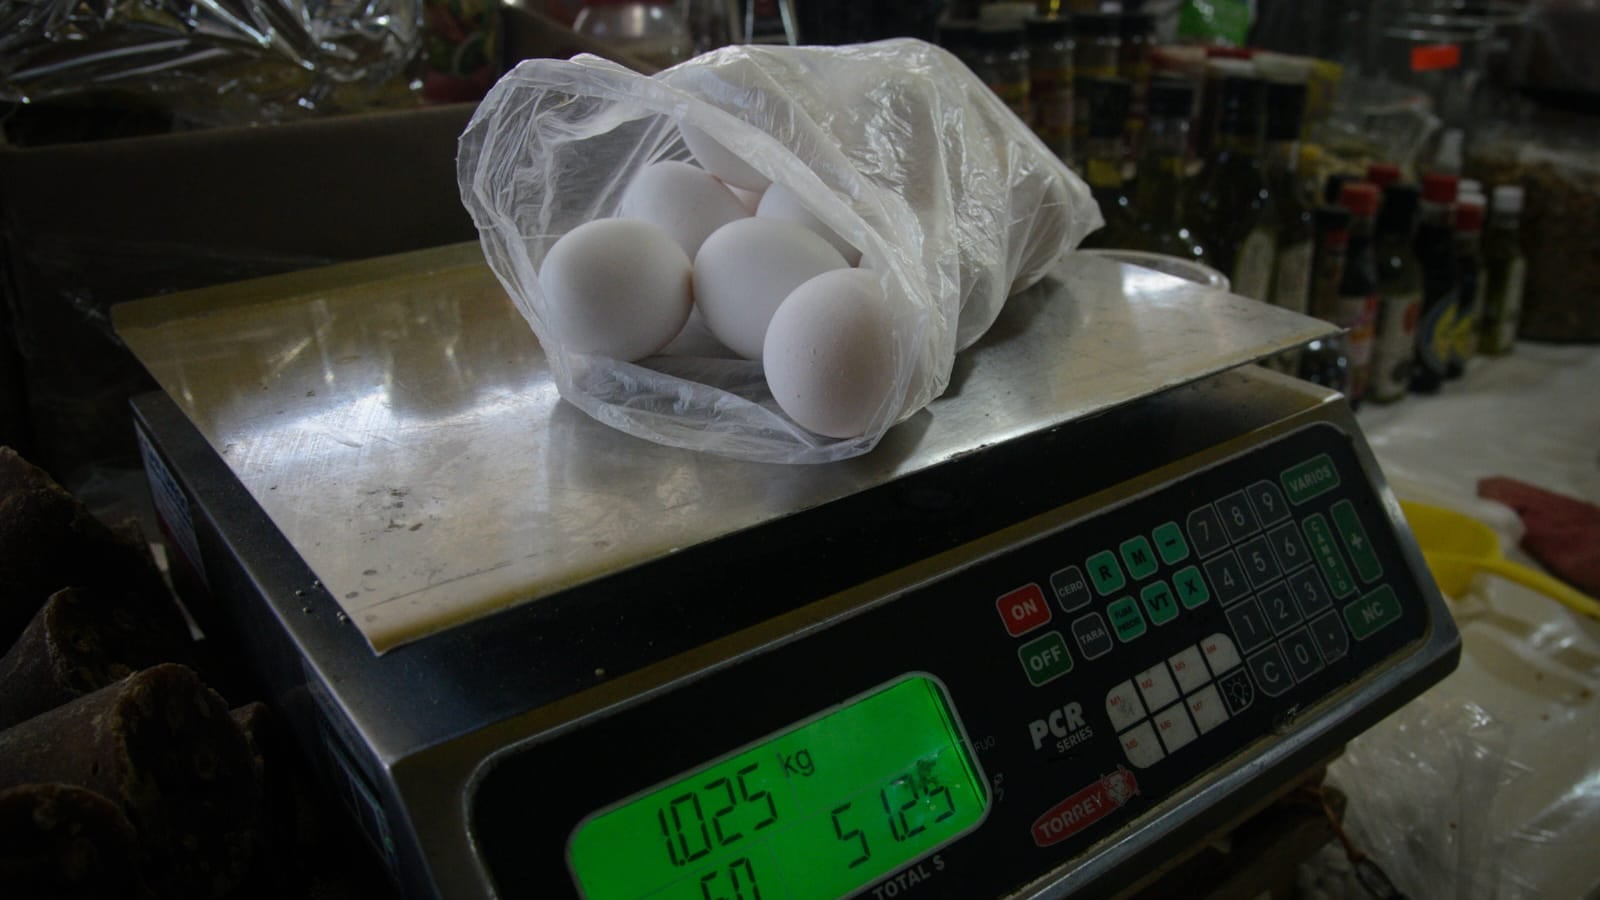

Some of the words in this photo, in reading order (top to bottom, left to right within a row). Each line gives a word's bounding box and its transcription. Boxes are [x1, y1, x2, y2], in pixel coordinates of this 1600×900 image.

[1289, 464, 1332, 493] VARIOS
[1262, 491, 1275, 513] 9
[1231, 506, 1246, 527] 8
[1198, 520, 1209, 542] 7
[1284, 536, 1297, 557] 6
[1131, 549, 1148, 567] M
[1252, 551, 1266, 573] 5
[1099, 564, 1113, 582] R
[1223, 567, 1235, 588] 4
[1058, 580, 1084, 598] CERO
[1184, 579, 1199, 596] X
[1304, 581, 1317, 601] 3
[1011, 597, 1039, 622] ON
[1149, 592, 1169, 613] VT
[1274, 598, 1288, 620] 2
[1361, 601, 1384, 625] NC
[1242, 614, 1256, 636] 1
[1080, 627, 1105, 646] TARA
[1029, 644, 1064, 673] OFF
[1295, 643, 1309, 665] 0
[1263, 661, 1279, 683] C
[1028, 701, 1086, 750] PCR
[1056, 726, 1094, 753] SERIES
[784, 748, 815, 778] kg
[1038, 792, 1105, 839] TORREY
[872, 864, 931, 900] TOTAL
